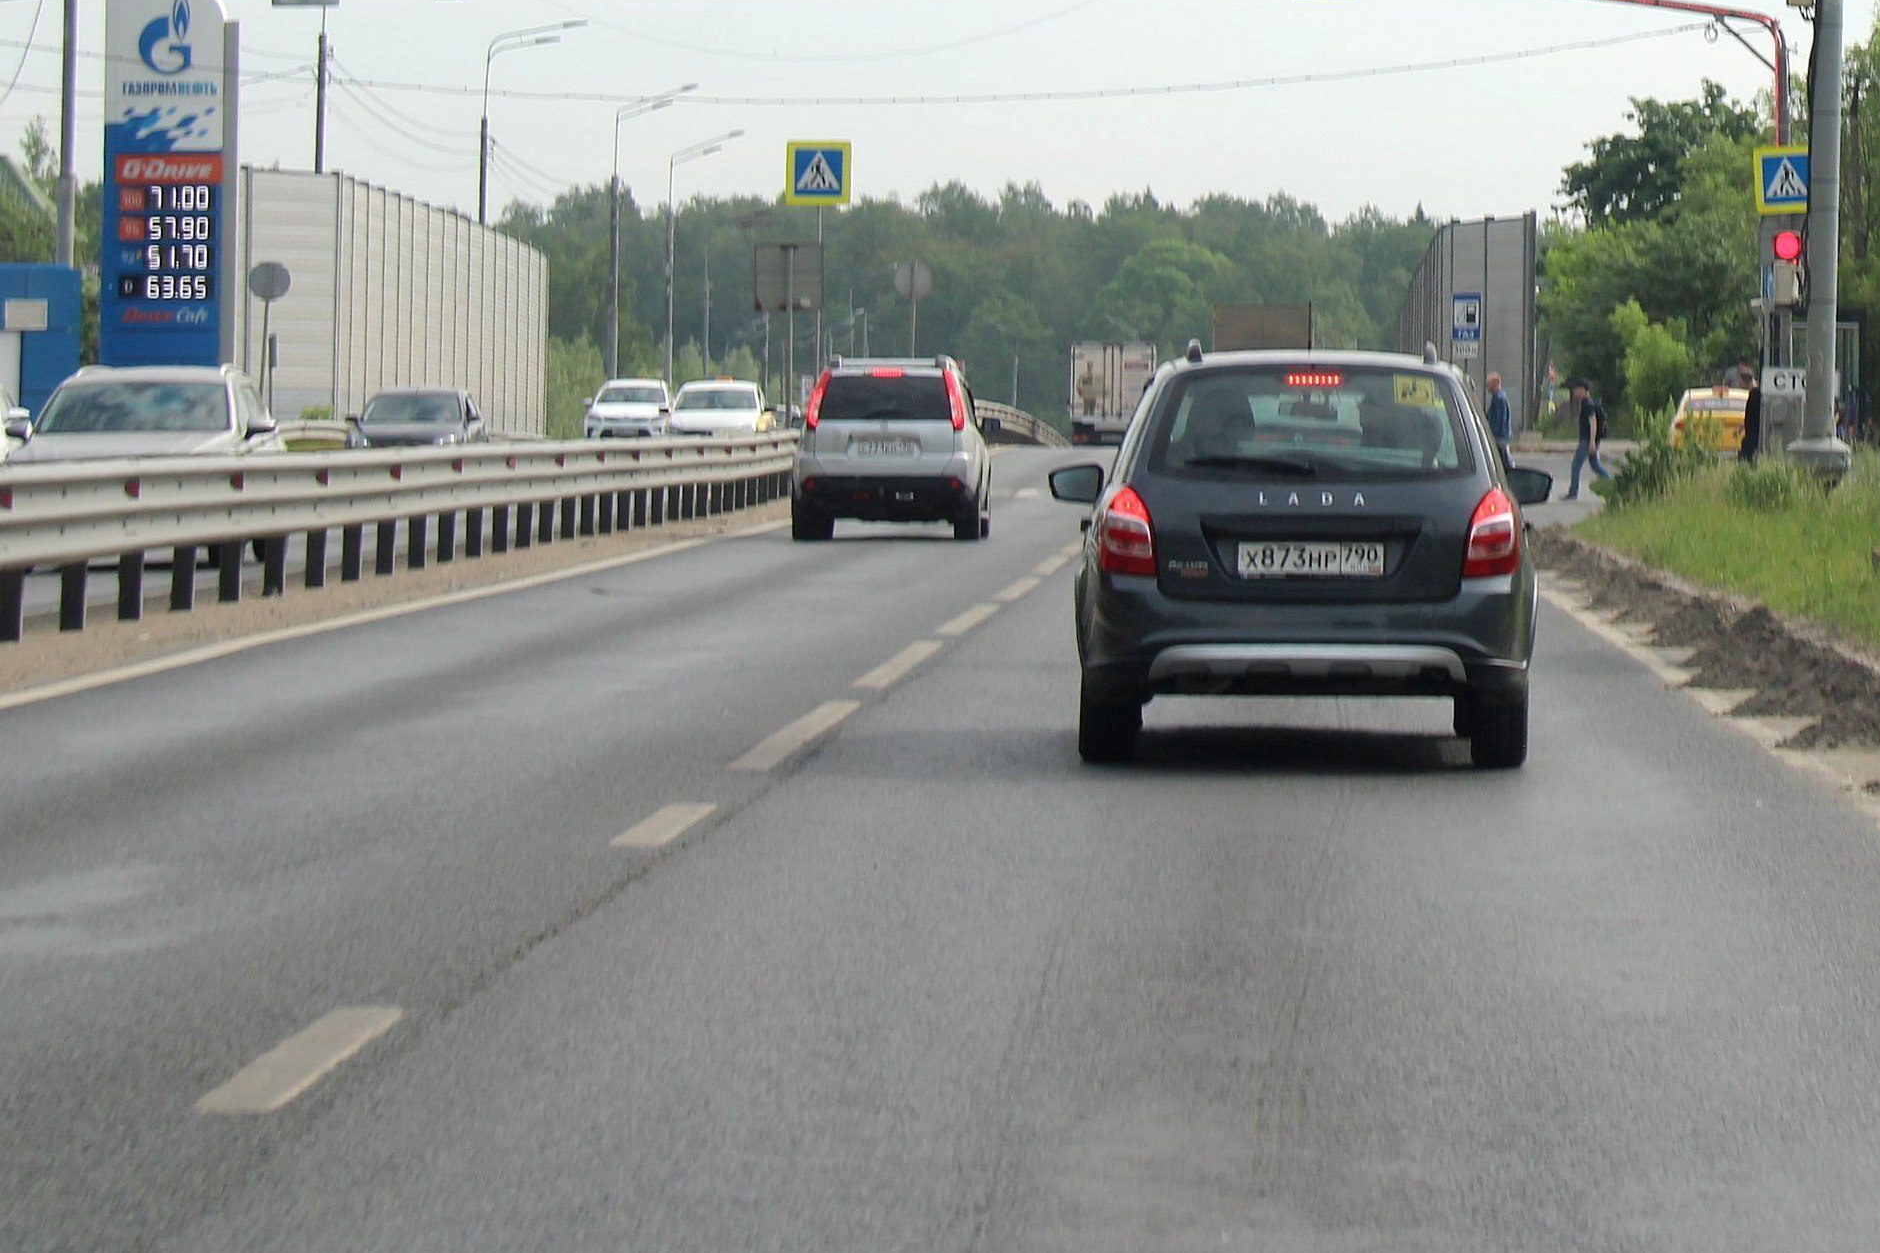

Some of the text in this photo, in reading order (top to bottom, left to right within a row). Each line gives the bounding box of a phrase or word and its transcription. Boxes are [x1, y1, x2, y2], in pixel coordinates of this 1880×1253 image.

[122, 80, 218, 96] ГАЗПРОМНЕФТЬ
[150, 186, 210, 212] 71.00
[148, 216, 209, 241] 57.90
[148, 245, 208, 270] 51.70
[147, 276, 207, 299] 63.65
[1258, 491, 1366, 507] LADA
[1344, 544, 1378, 563] 790
